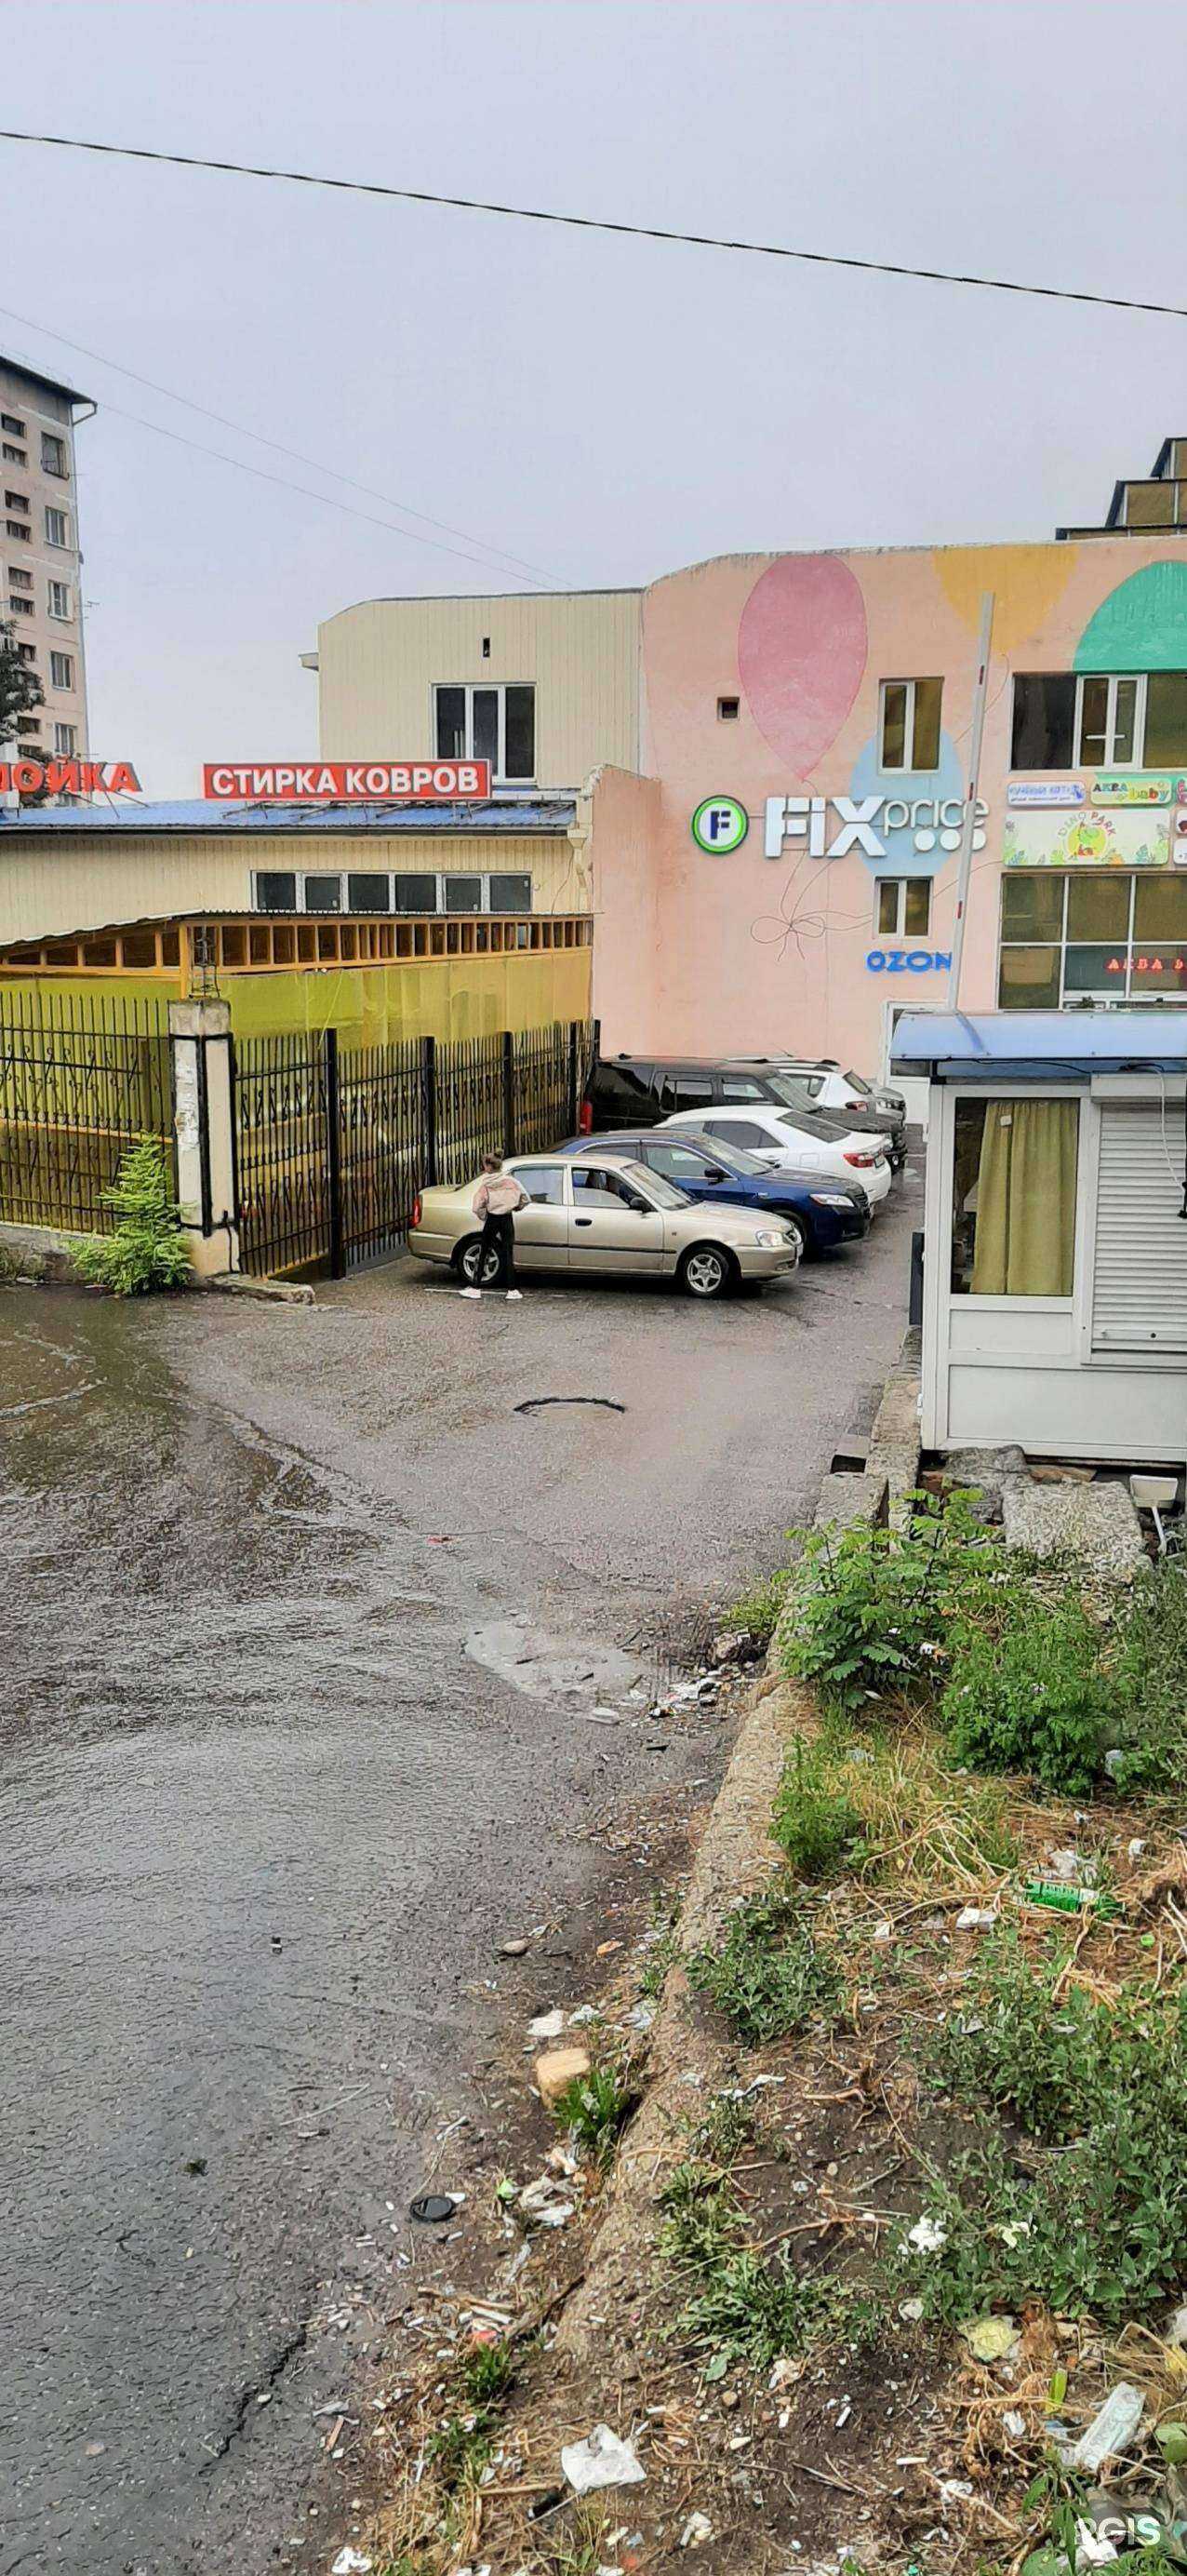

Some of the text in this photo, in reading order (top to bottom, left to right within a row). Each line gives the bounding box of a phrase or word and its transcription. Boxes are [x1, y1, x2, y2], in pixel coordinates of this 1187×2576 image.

[212, 766, 479, 796] СТИРКА КОВРОВ
[884, 798, 990, 837] price
[866, 950, 954, 973] OZON
